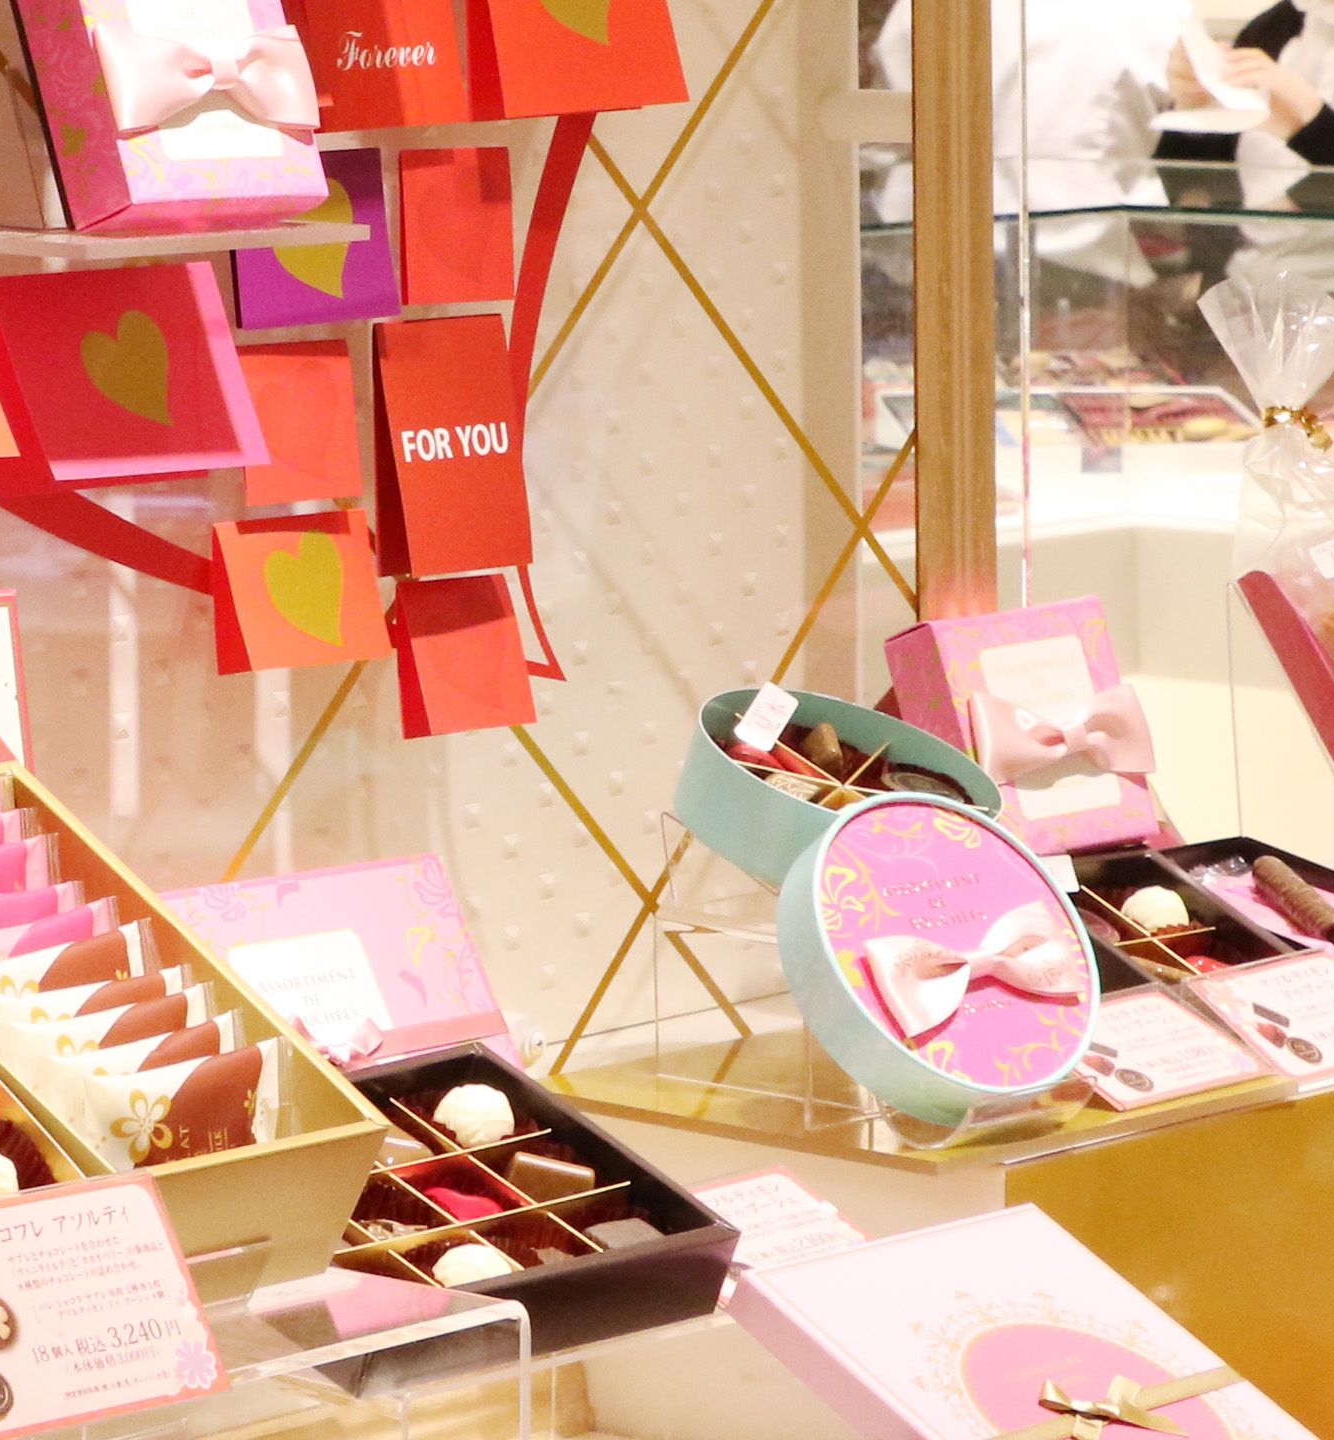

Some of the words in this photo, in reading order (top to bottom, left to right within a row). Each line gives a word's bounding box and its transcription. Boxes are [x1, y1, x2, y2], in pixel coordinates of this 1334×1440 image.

[336, 30, 437, 71] Forever
[400, 426, 454, 463] FOR
[454, 421, 510, 458] YOU
[258, 967, 357, 994] ASSORTIMENT
[302, 993, 324, 1008] DE
[51, 1204, 130, 1234] アソルティ
